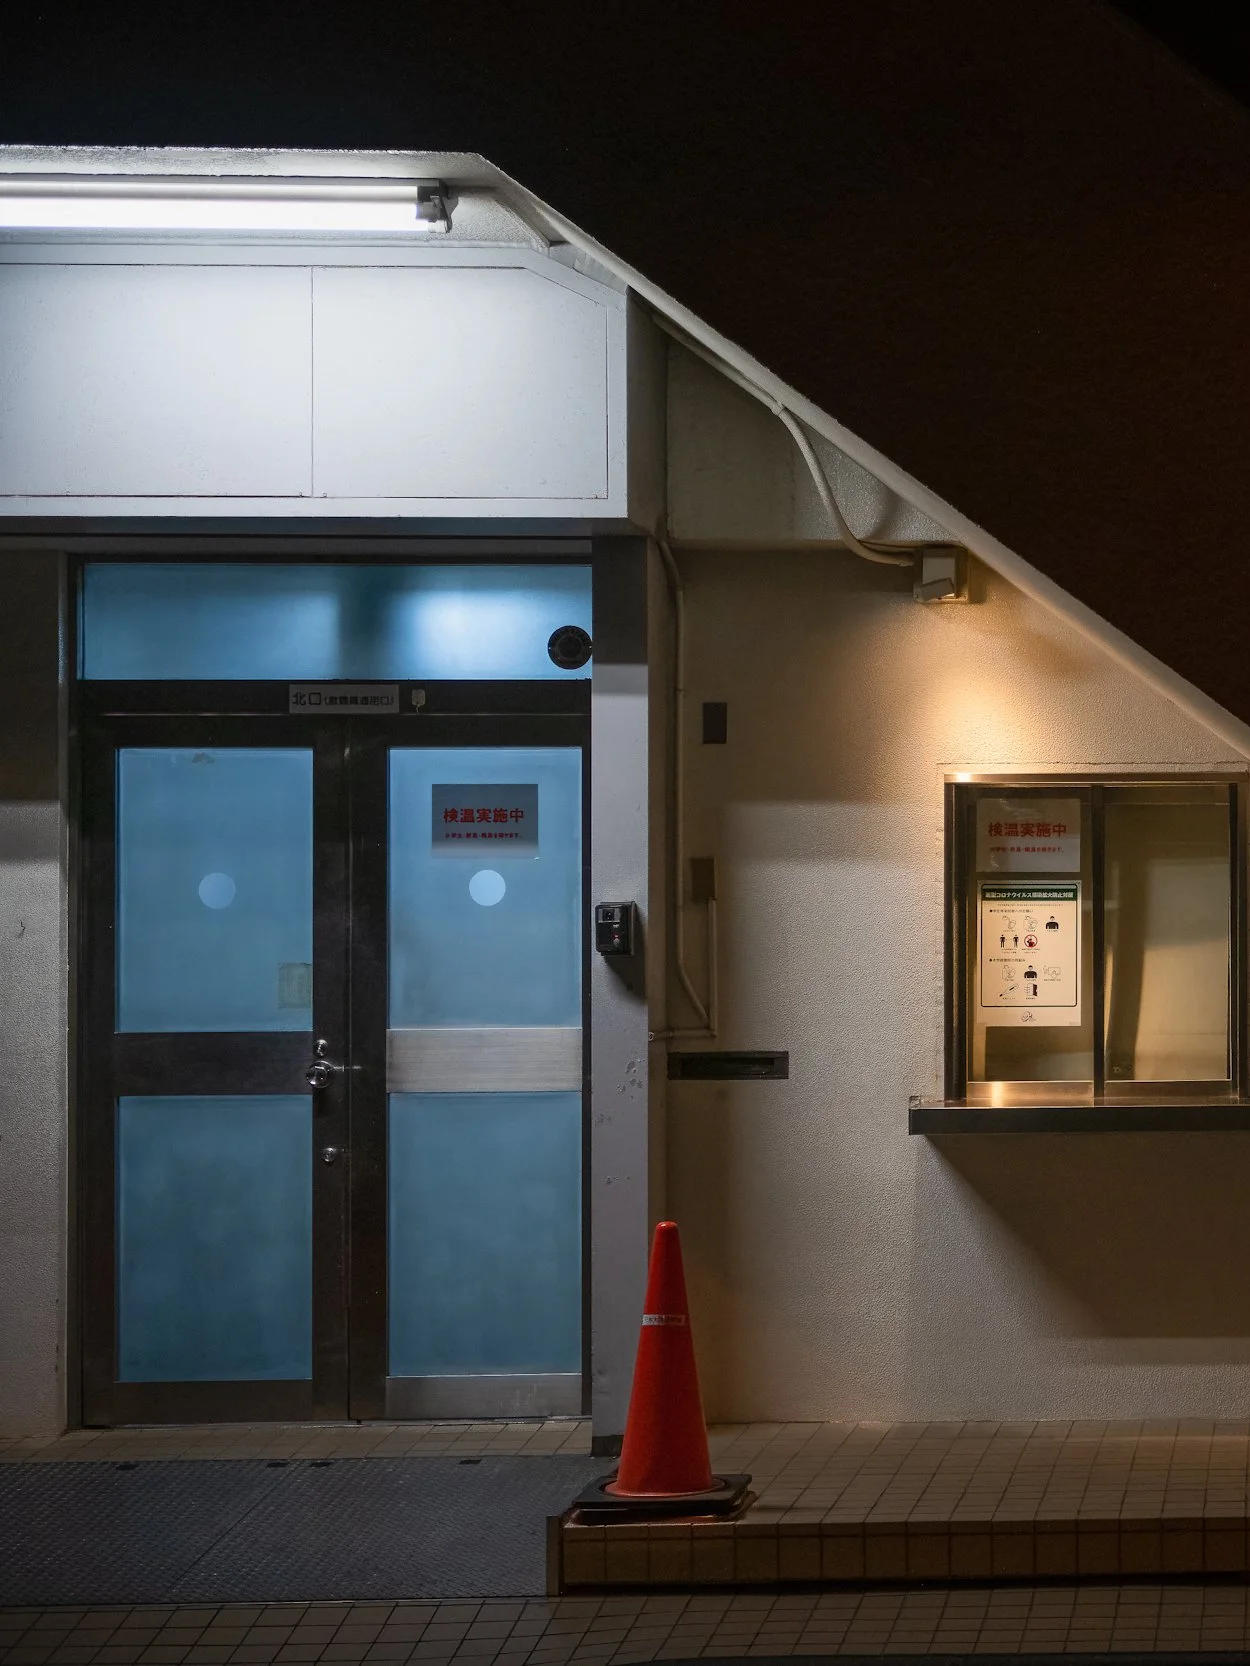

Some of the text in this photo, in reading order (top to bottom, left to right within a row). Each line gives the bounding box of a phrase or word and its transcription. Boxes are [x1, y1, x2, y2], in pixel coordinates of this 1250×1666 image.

[443, 808, 524, 823] 検温実施中
[988, 822, 1066, 837] 検温実施中
